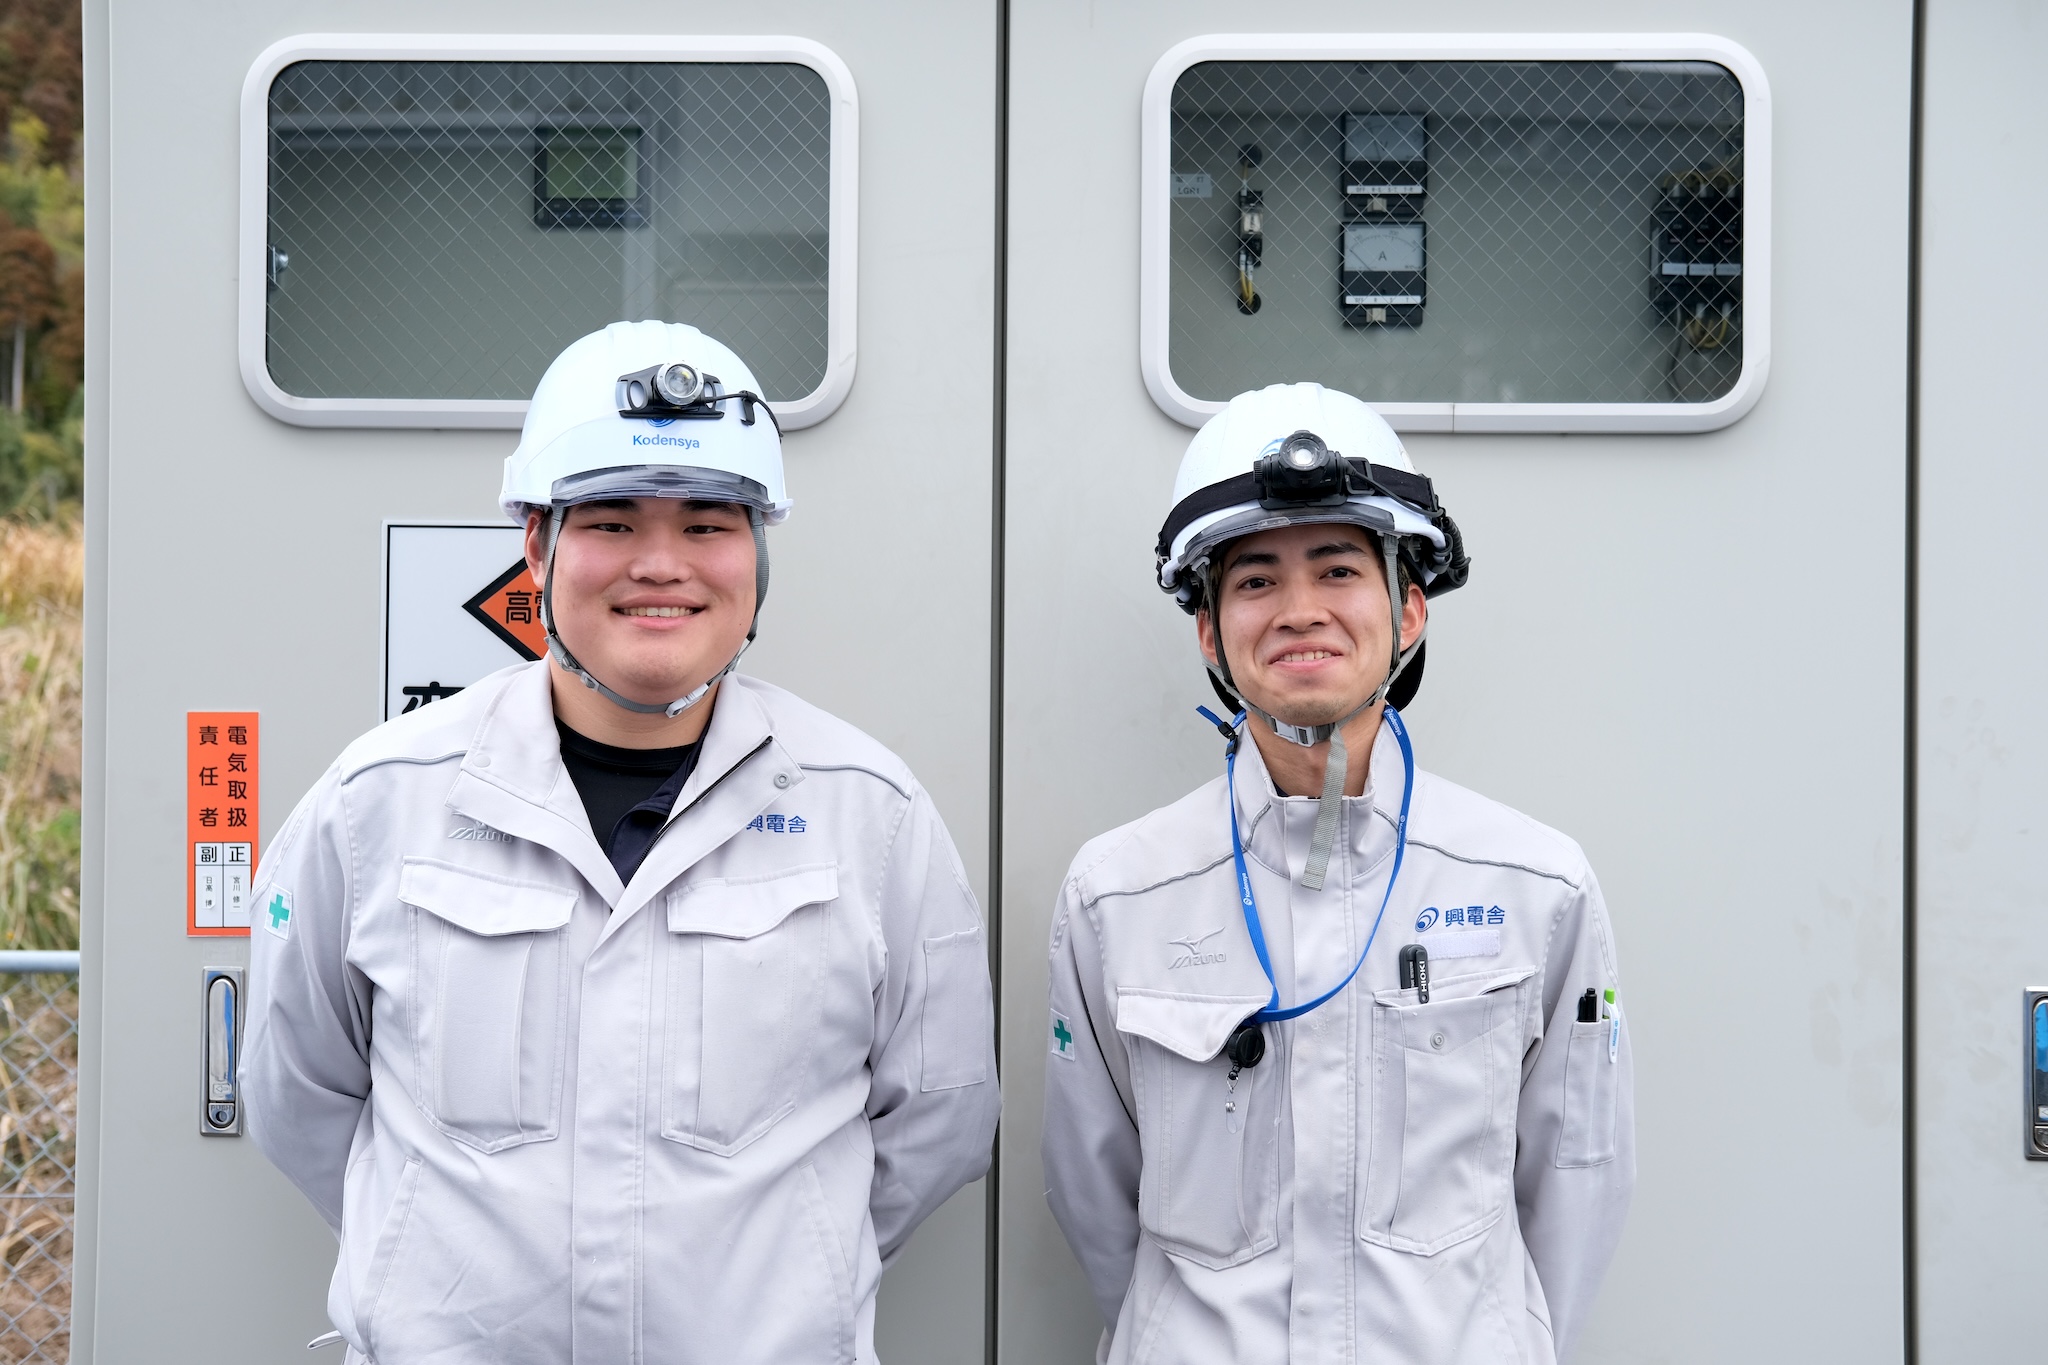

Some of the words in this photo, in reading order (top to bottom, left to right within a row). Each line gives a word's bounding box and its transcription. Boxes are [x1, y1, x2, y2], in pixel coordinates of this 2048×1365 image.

[1378, 250, 1387, 261] A
[633, 434, 700, 449] Kodensya
[505, 590, 542, 625] 高
[199, 725, 219, 828] 責任者
[228, 725, 248, 828] 電気取扱
[201, 846, 217, 862] 副
[229, 846, 246, 862] 正
[1419, 960, 1428, 992] HIOKI
